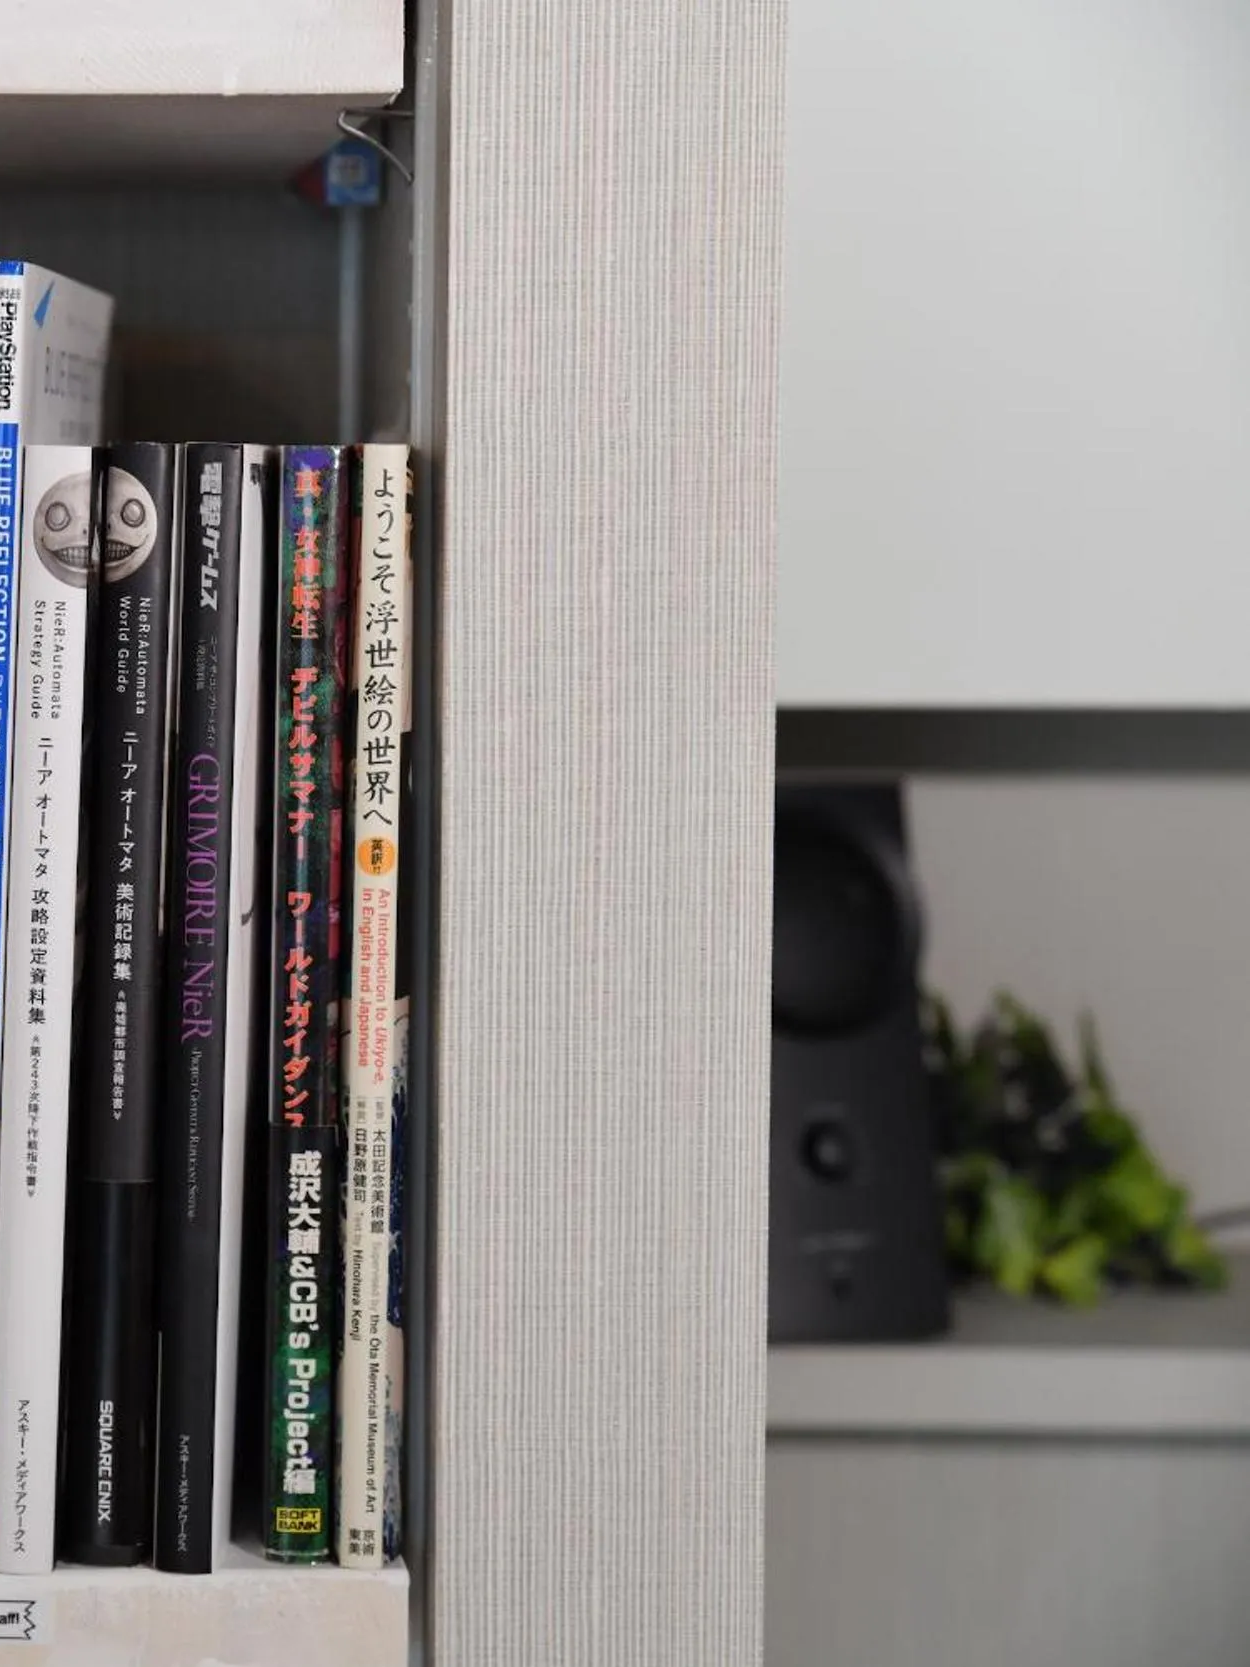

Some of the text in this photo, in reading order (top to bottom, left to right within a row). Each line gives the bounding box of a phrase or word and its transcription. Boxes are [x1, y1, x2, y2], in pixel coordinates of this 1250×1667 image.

[30, 600, 46, 720] Strategy Guide
[50, 601, 67, 720] NieR:Automata
[116, 596, 132, 693] World Guide
[135, 597, 152, 716] NieR:Automata
[362, 468, 399, 826] ようこそ浮世絵の世界へ
[288, 666, 320, 861] デビルサマナー
[28, 738, 54, 1025] ニーア オートマタ 攻略設定資料集
[112, 732, 140, 981] ニーア オートマタ 美術記録集
[181, 753, 221, 1044] GRIMOIRE NieR
[378, 887, 391, 909] An
[357, 887, 375, 1068] in English and Japanese
[376, 912, 391, 1005] Introduction
[375, 1009, 389, 1022] to
[370, 1128, 387, 1234] 太田記念美術館
[349, 1308, 364, 1342] Kenji
[351, 1249, 364, 1305] Hinohara
[369, 1314, 380, 1335] the
[367, 1363, 380, 1422] Memorial
[12, 1399, 31, 1553] アスキー・メディアワークス
[97, 1400, 114, 1523] SQUARE ENIX
[365, 1479, 377, 1492] of
[366, 1423, 378, 1475] Museum
[278, 1509, 318, 1519] SOFT
[278, 1520, 319, 1530] BANK
[365, 1495, 377, 1514] Art
